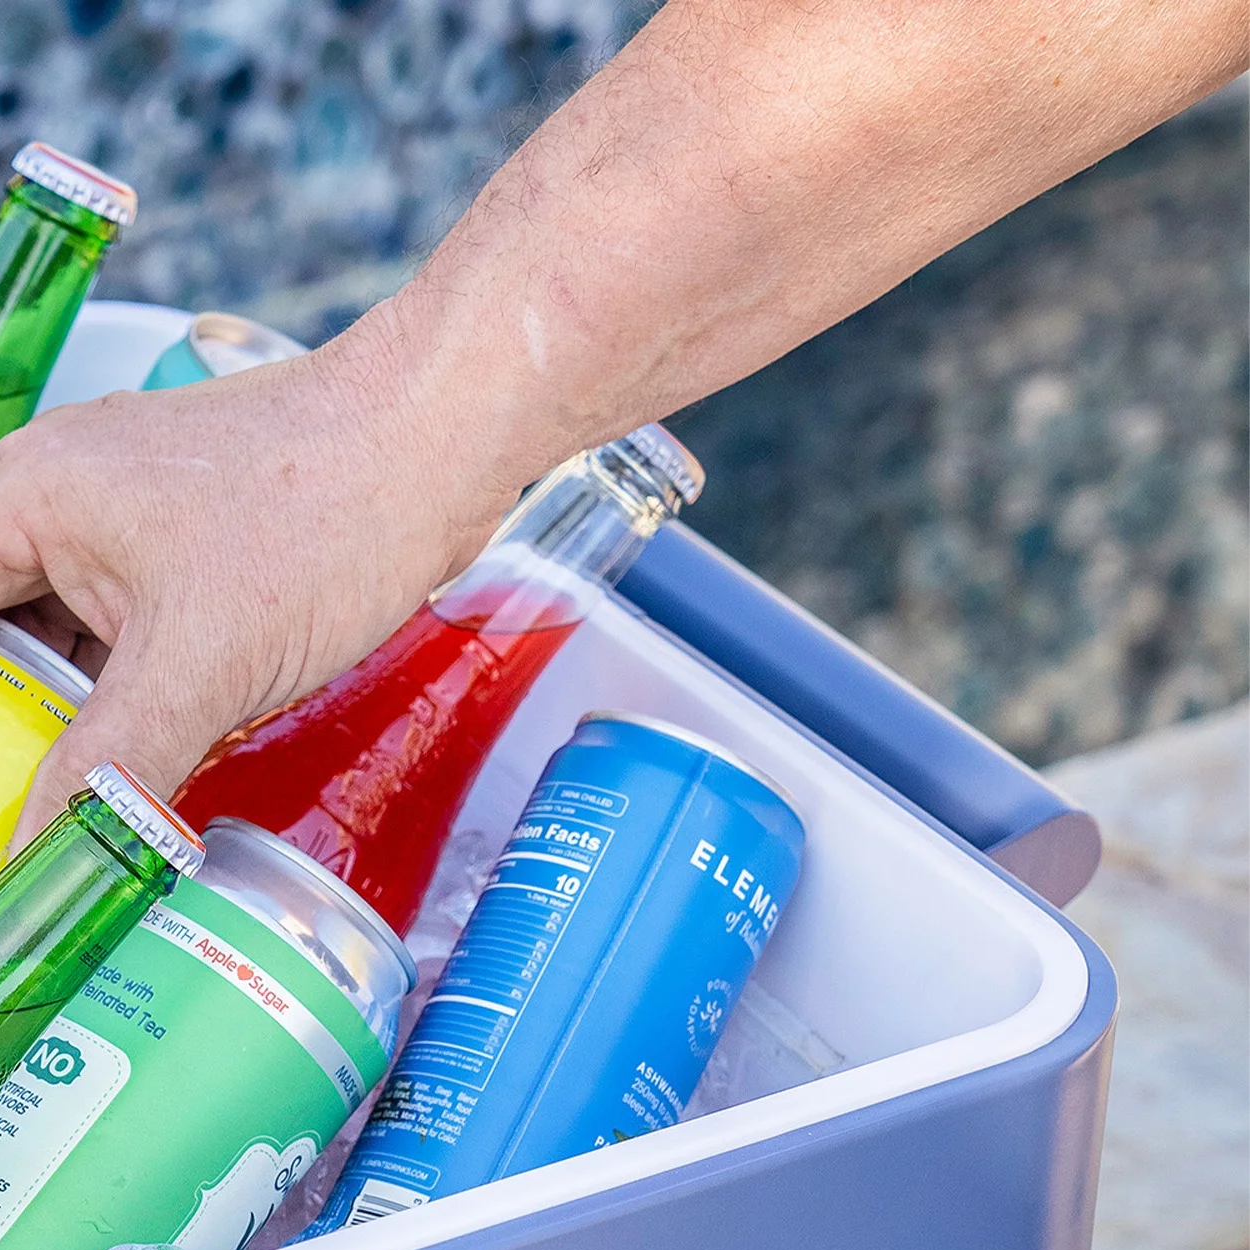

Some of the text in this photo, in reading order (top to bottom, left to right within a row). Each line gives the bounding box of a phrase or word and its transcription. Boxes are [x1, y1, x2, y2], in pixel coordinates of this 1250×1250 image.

[580, 792, 613, 808] CHILLED
[544, 821, 602, 852] Facts
[553, 872, 581, 896] 10
[142, 907, 163, 927] DE
[160, 915, 196, 945] WITH
[192, 935, 241, 974] Apple
[96, 965, 154, 1003] ade with
[80, 980, 167, 1040] feinated Tea
[30, 1042, 75, 1078] NO
[4, 1081, 43, 1108] RTIFICIAL
[622, 1092, 646, 1117] sleep
[631, 1077, 660, 1111] 250mg
[427, 1127, 438, 1138] for
